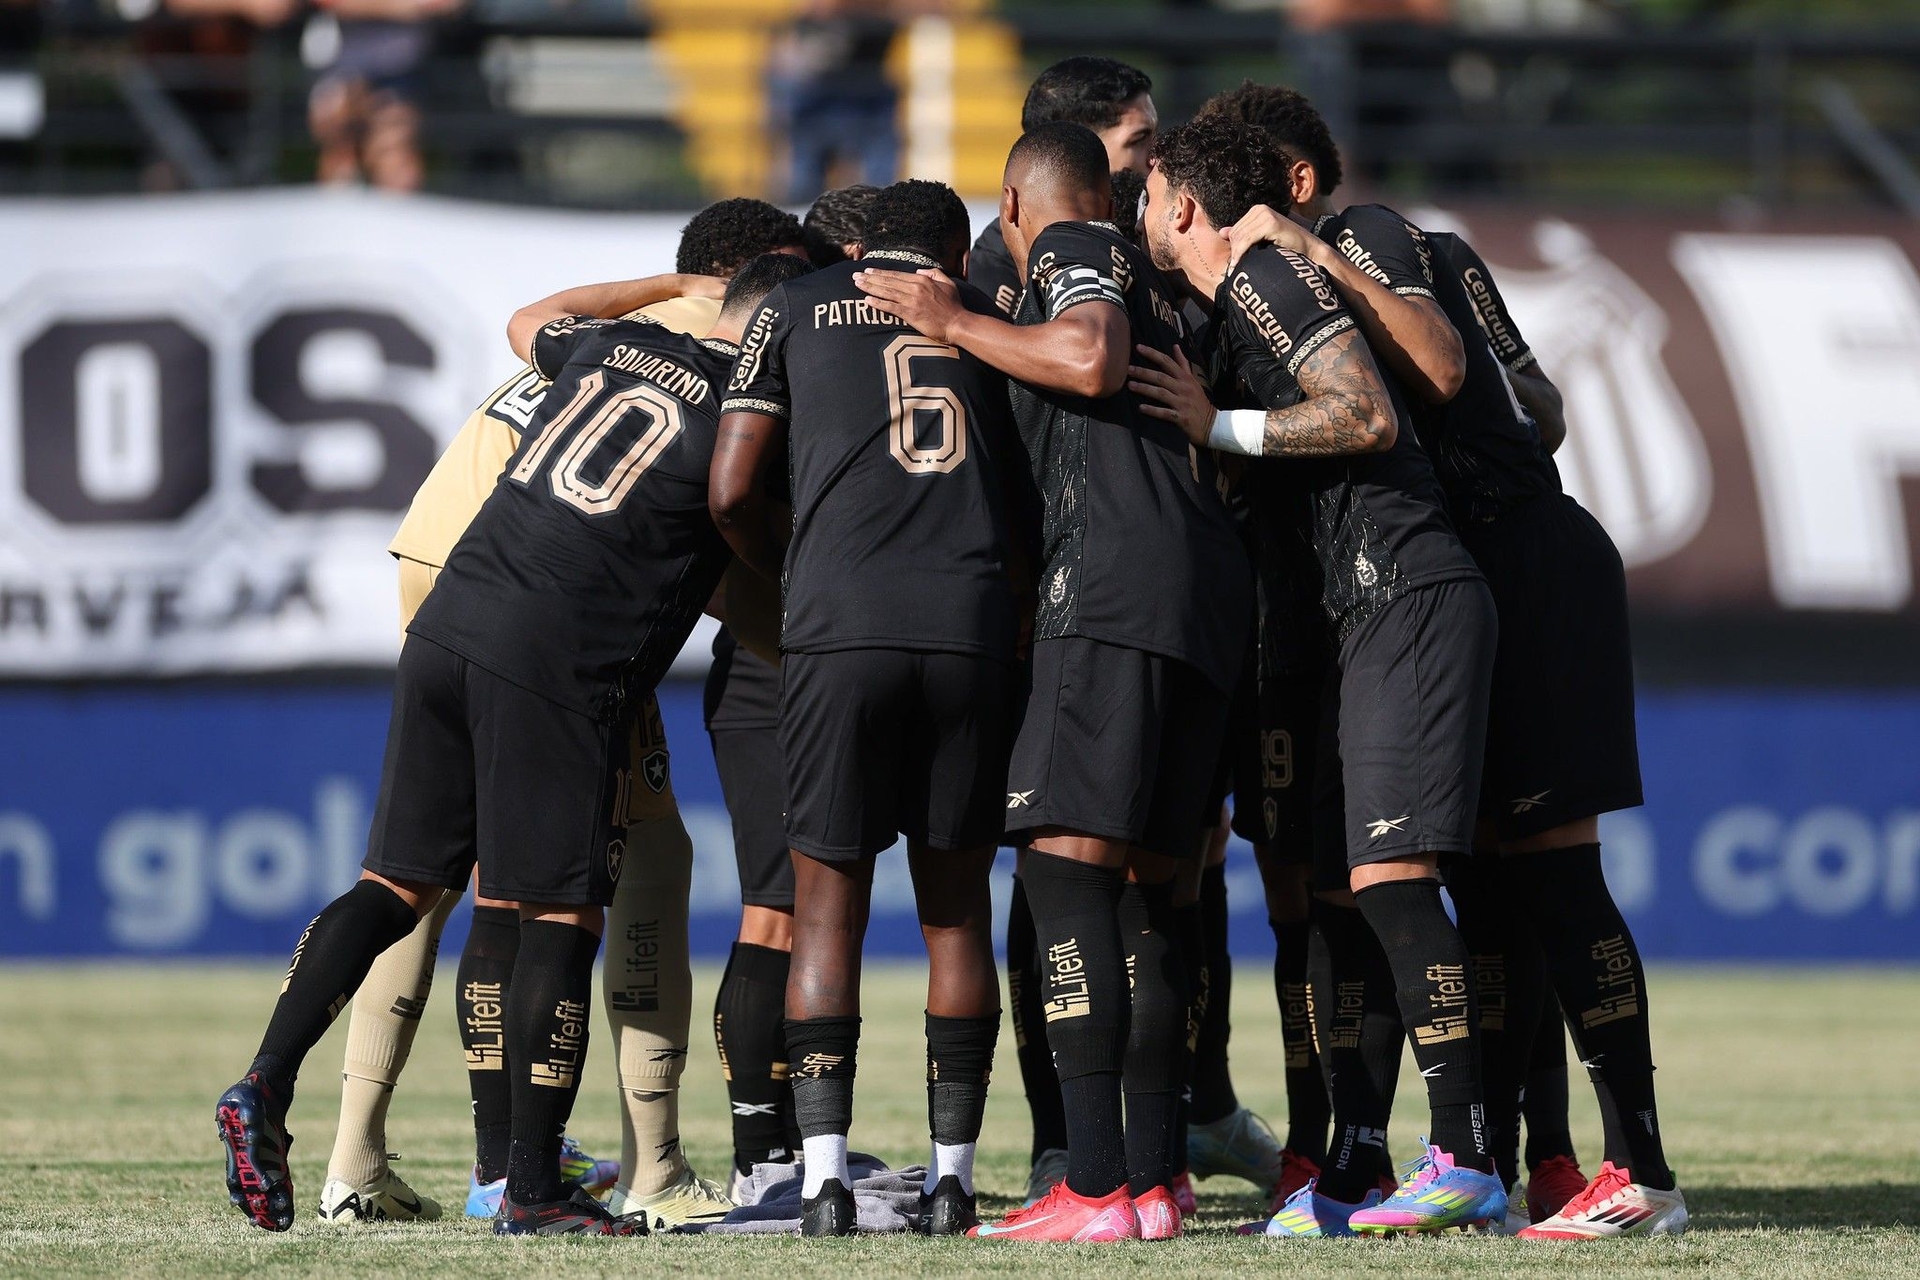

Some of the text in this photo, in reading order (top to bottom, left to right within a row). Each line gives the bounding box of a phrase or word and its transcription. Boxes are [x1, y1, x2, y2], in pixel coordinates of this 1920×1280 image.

[1336, 228, 1391, 286] Centrum
[1232, 271, 1293, 355] Centrum
[1463, 266, 1518, 355] Centrum
[603, 344, 709, 406] SAVARINO
[729, 307, 774, 392] Centrum
[883, 335, 967, 474] 6
[510, 369, 683, 516] 10
[1692, 803, 1920, 918] co
[626, 919, 660, 989] Lifefit
[1049, 938, 1090, 1000] Lifefit
[1591, 934, 1635, 1010] Lifefit
[465, 981, 503, 1055] Lifefit
[1333, 980, 1364, 1034] Lifefit
[1426, 963, 1468, 1023] Lifefit
[549, 999, 586, 1068] Lifefit
[1470, 1103, 1486, 1155] DESIGN
